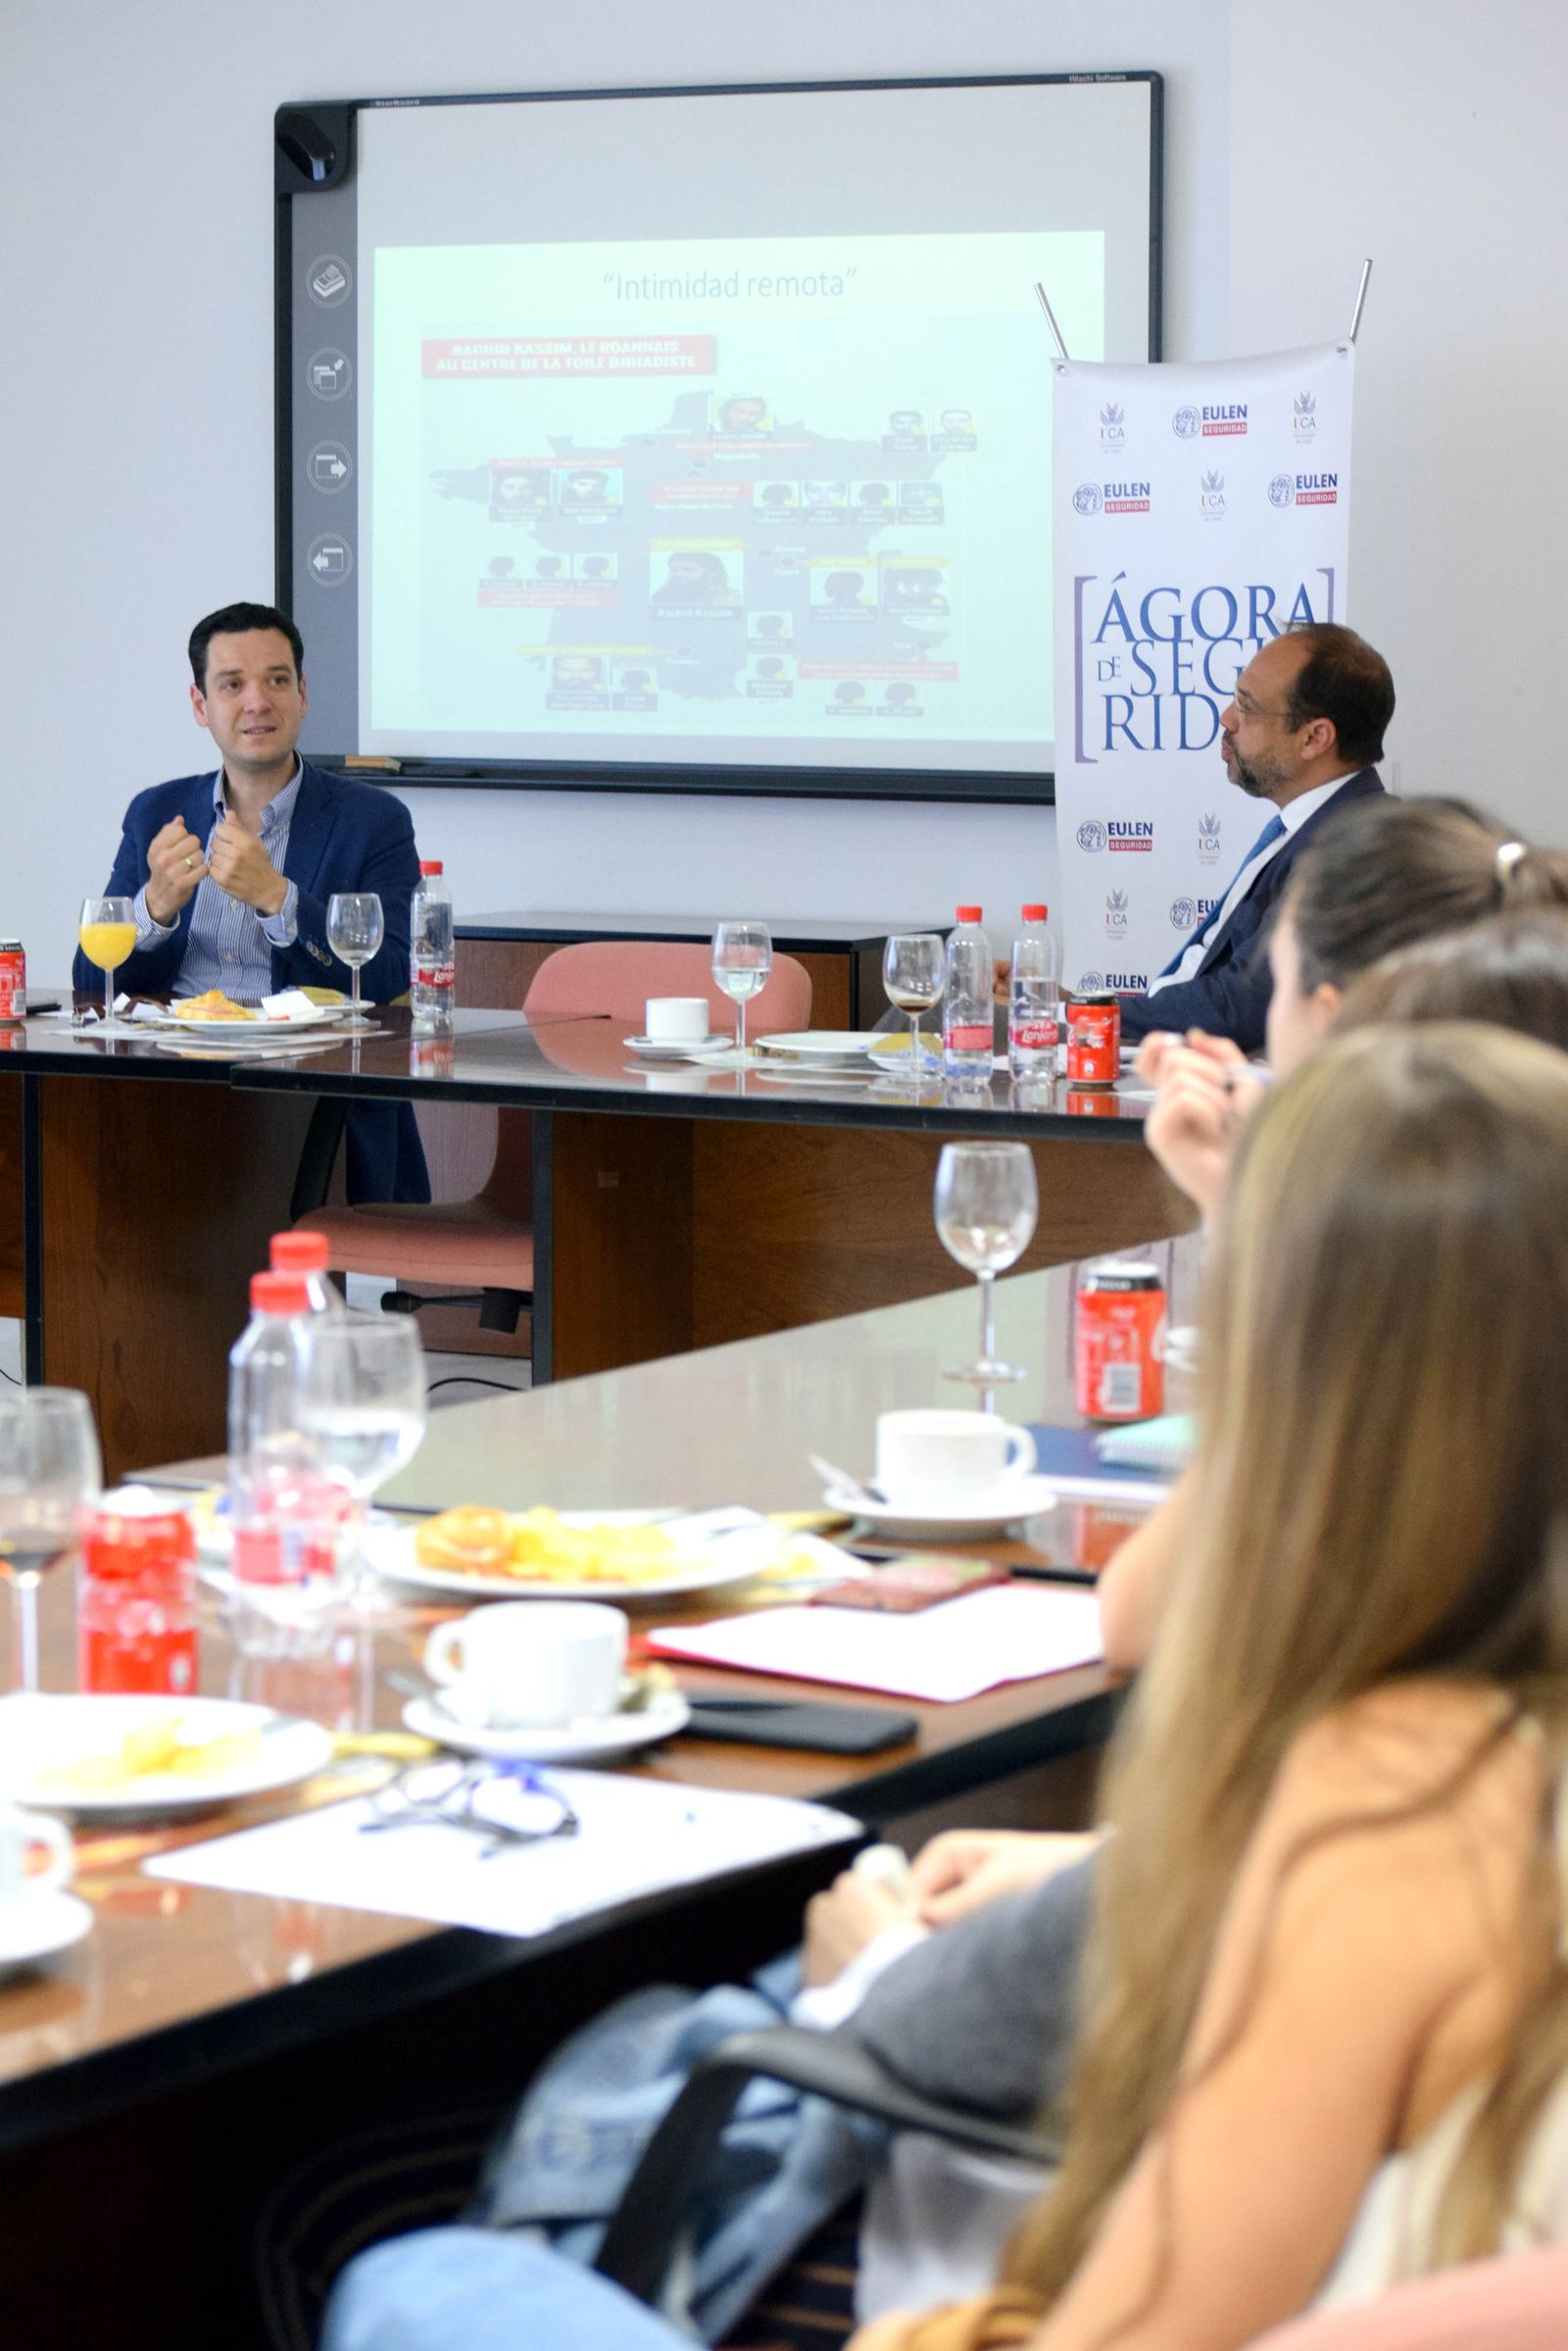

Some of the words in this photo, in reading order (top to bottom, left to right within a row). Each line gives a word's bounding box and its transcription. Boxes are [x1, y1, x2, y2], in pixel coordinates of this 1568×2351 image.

[1201, 405, 1248, 419] EULEN
[1203, 422, 1248, 436] SEGURIDAD
[1296, 473, 1338, 490] EULEN
[1103, 482, 1151, 498] EULEN
[1297, 492, 1337, 506] SEGURIDAD
[1104, 501, 1150, 513] SEGURIDAD
[1091, 570, 1316, 644] ÁGORA
[1098, 656, 1121, 683] DE
[1130, 638, 1264, 697] SEG
[1102, 693, 1220, 751] RID
[1107, 822, 1153, 836] EULEN
[1109, 840, 1152, 851] SEGURIDAD
[1105, 974, 1148, 989] EULEN
